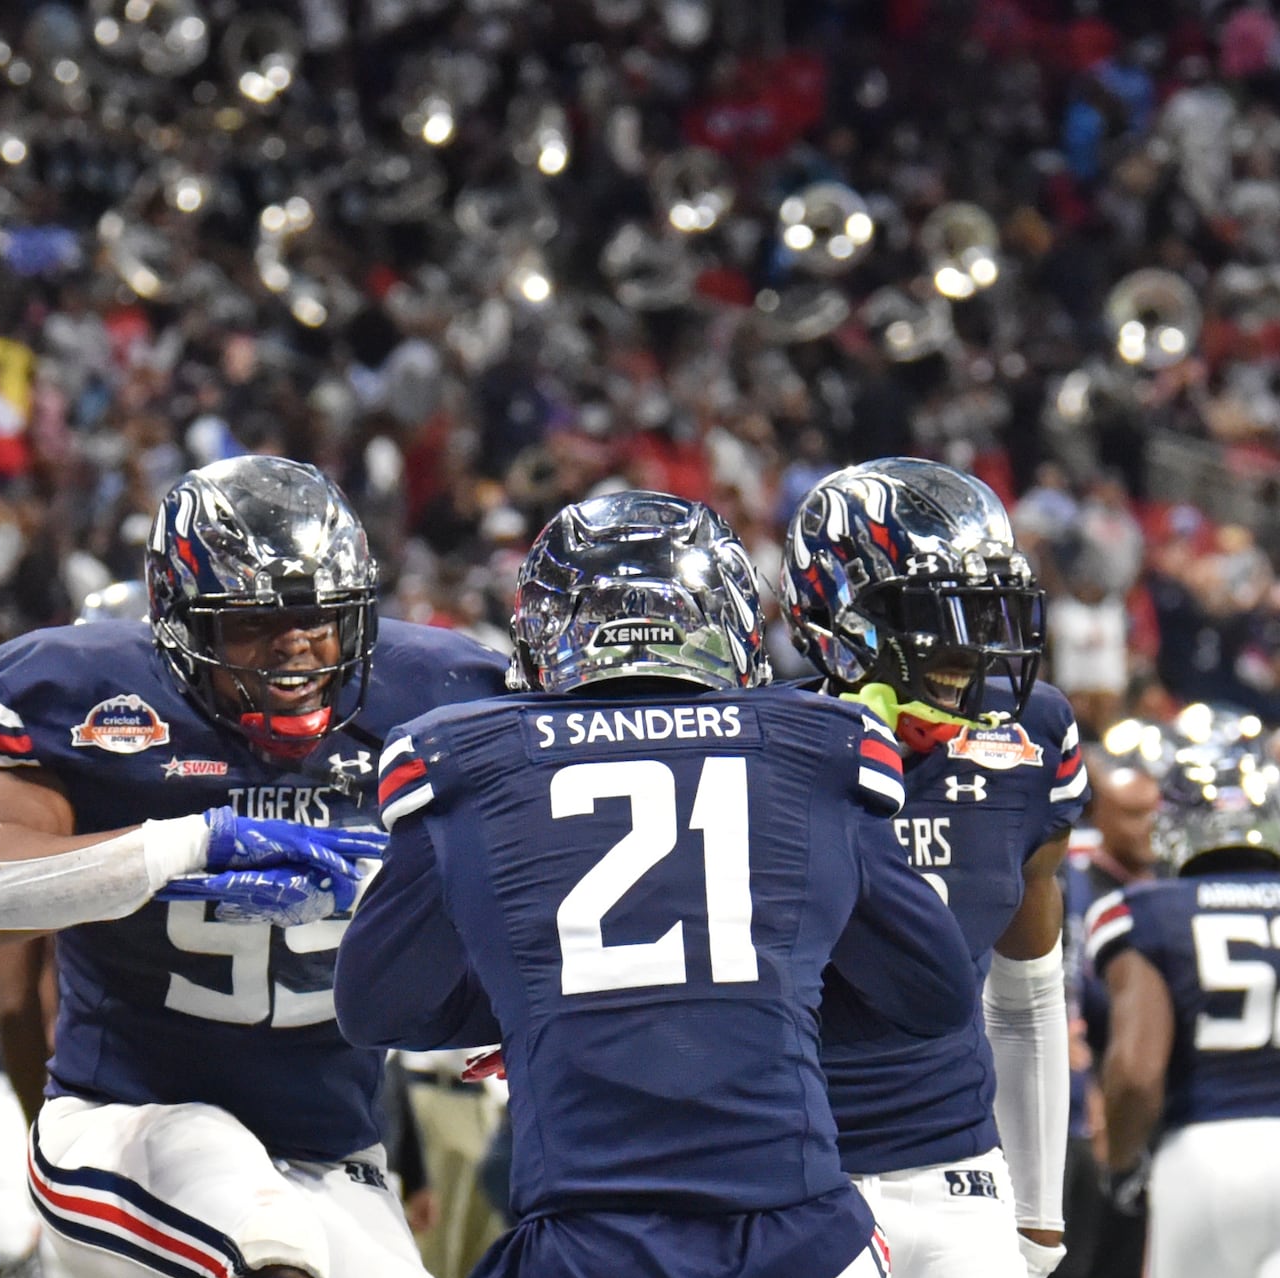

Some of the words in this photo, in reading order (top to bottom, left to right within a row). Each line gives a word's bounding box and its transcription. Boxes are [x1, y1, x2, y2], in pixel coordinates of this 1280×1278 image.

[603, 626, 675, 644] XENITH
[102, 715, 142, 726] cricket
[536, 714, 556, 748] S
[566, 705, 741, 745] SANDERS
[91, 726, 154, 735] CELEBRATION
[975, 731, 1012, 742] cricket
[110, 735, 137, 744] BOWL
[228, 786, 332, 829] TIGERS
[550, 755, 759, 995] 21
